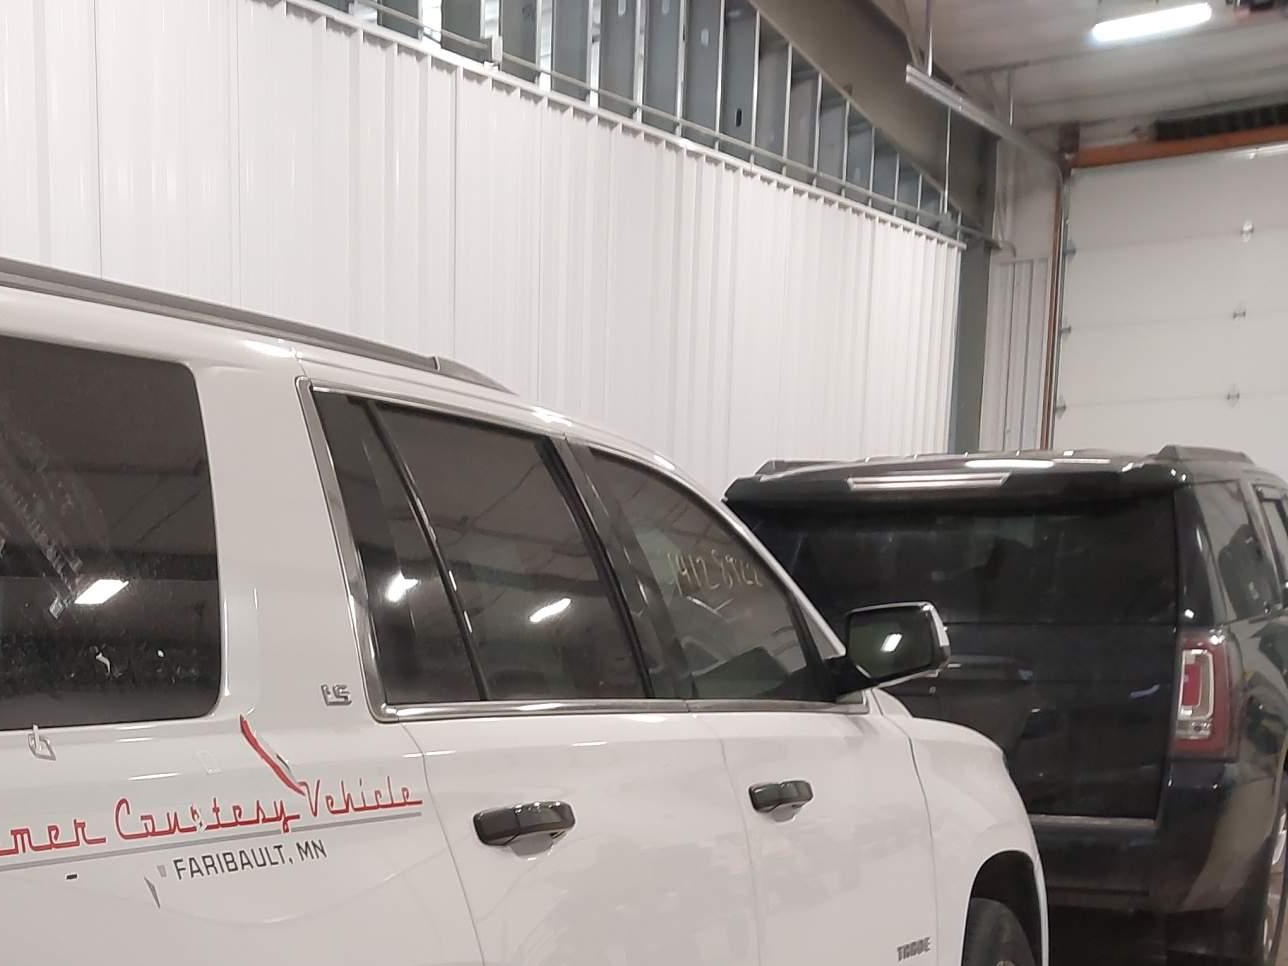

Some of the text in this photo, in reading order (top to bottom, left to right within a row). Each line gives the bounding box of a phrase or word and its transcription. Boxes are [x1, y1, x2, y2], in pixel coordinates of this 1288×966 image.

[320, 684, 352, 706] LS
[114, 797, 300, 840] Courtesy
[298, 775, 423, 817] Vehicle
[173, 839, 328, 880] FARIBAULT, MN
